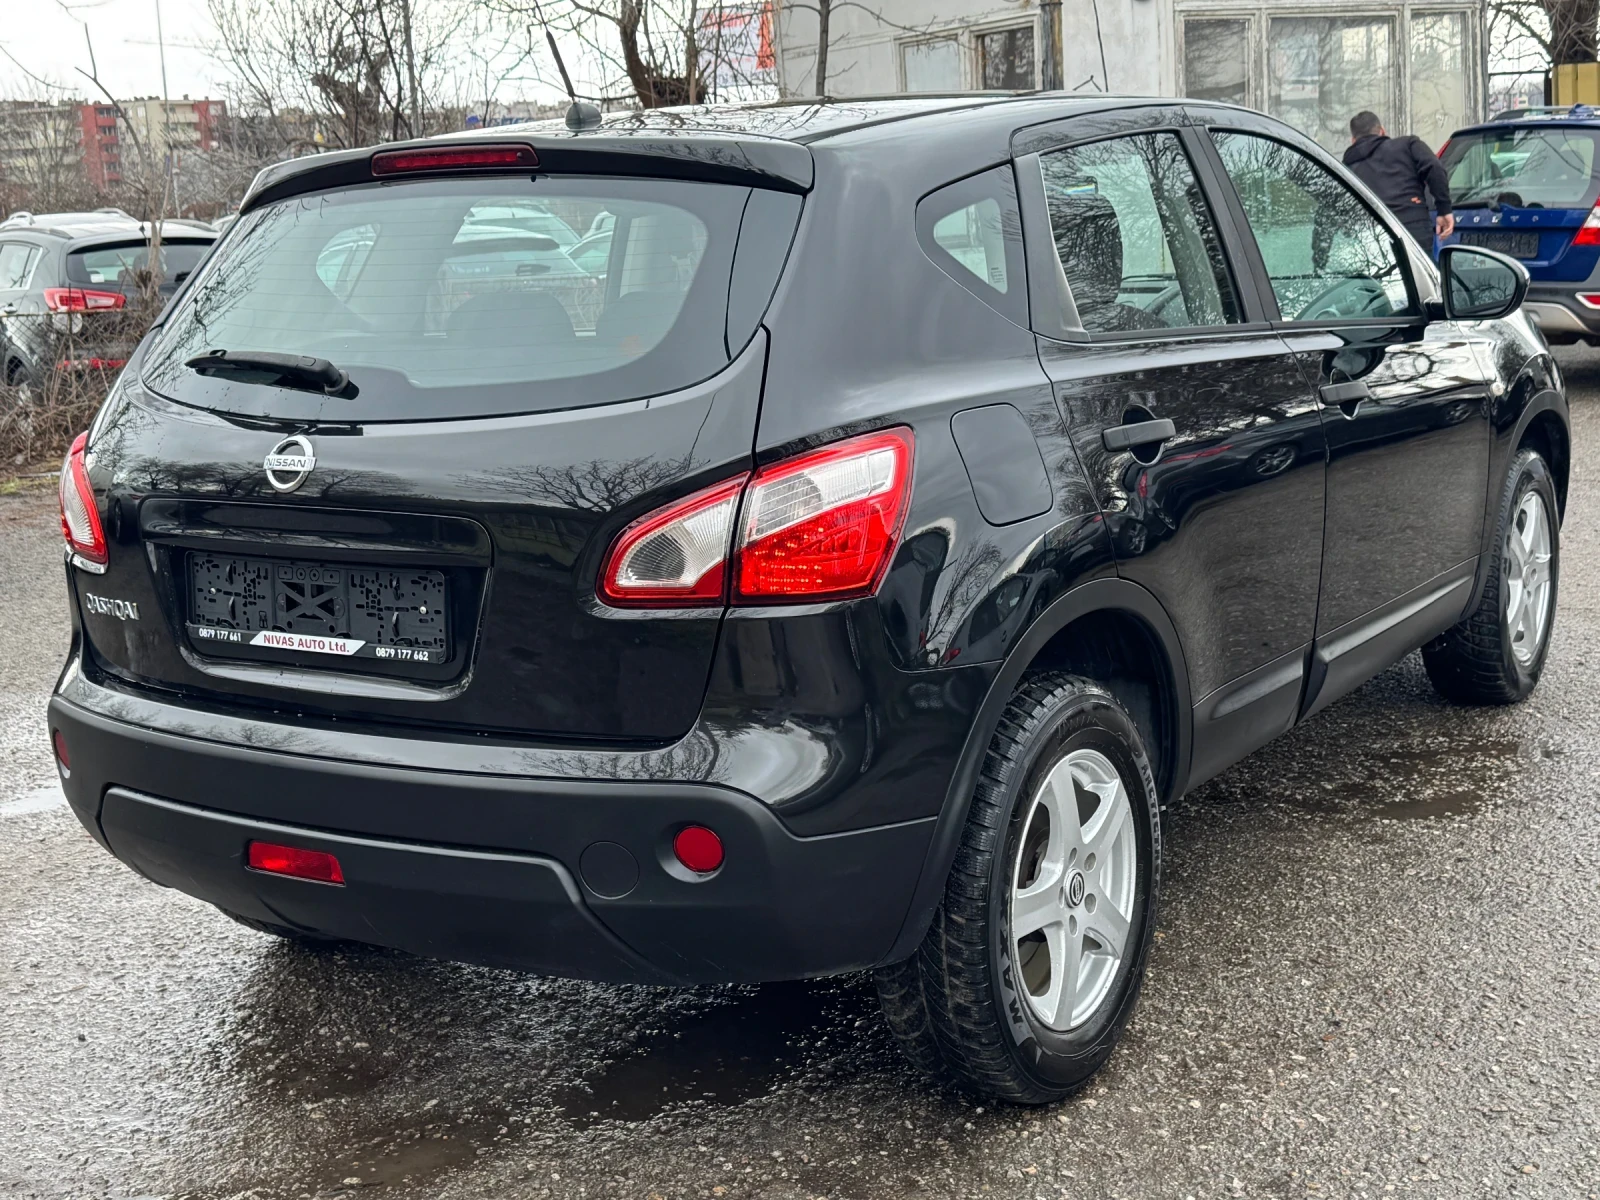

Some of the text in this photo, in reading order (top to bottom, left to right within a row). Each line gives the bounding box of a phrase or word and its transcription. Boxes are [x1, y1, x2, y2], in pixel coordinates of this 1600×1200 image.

[266, 457, 306, 468] NISSAN
[86, 592, 140, 620] QASHQAI
[198, 627, 242, 642] 0879 177 661
[263, 633, 350, 653] NIVAS AUTO Ltd.
[375, 647, 429, 661] 0879 177 662
